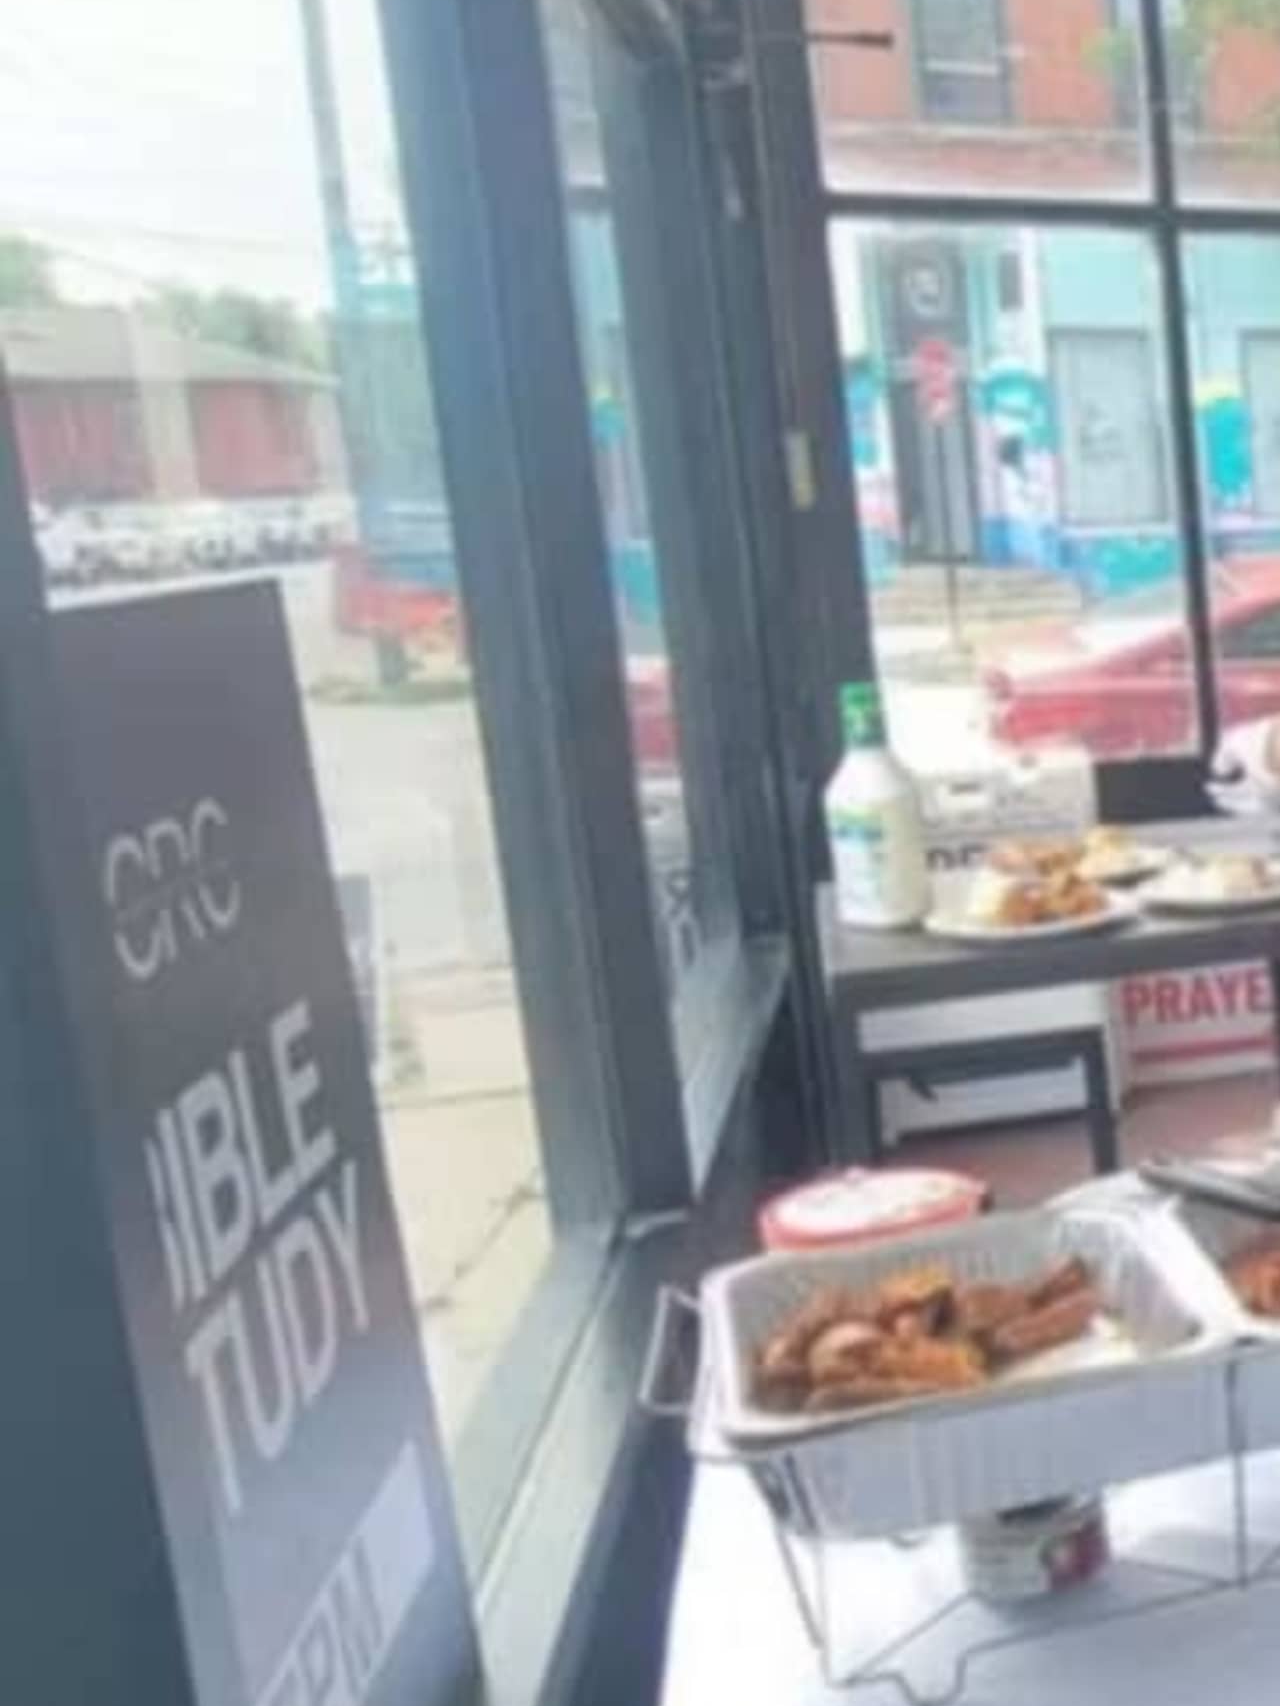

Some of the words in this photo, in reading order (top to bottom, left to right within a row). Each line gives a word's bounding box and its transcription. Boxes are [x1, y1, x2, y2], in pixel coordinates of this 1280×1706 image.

[104, 796, 241, 980] CRC
[1119, 966, 1274, 1030] PRAYE
[185, 1158, 369, 1517] TUDY
